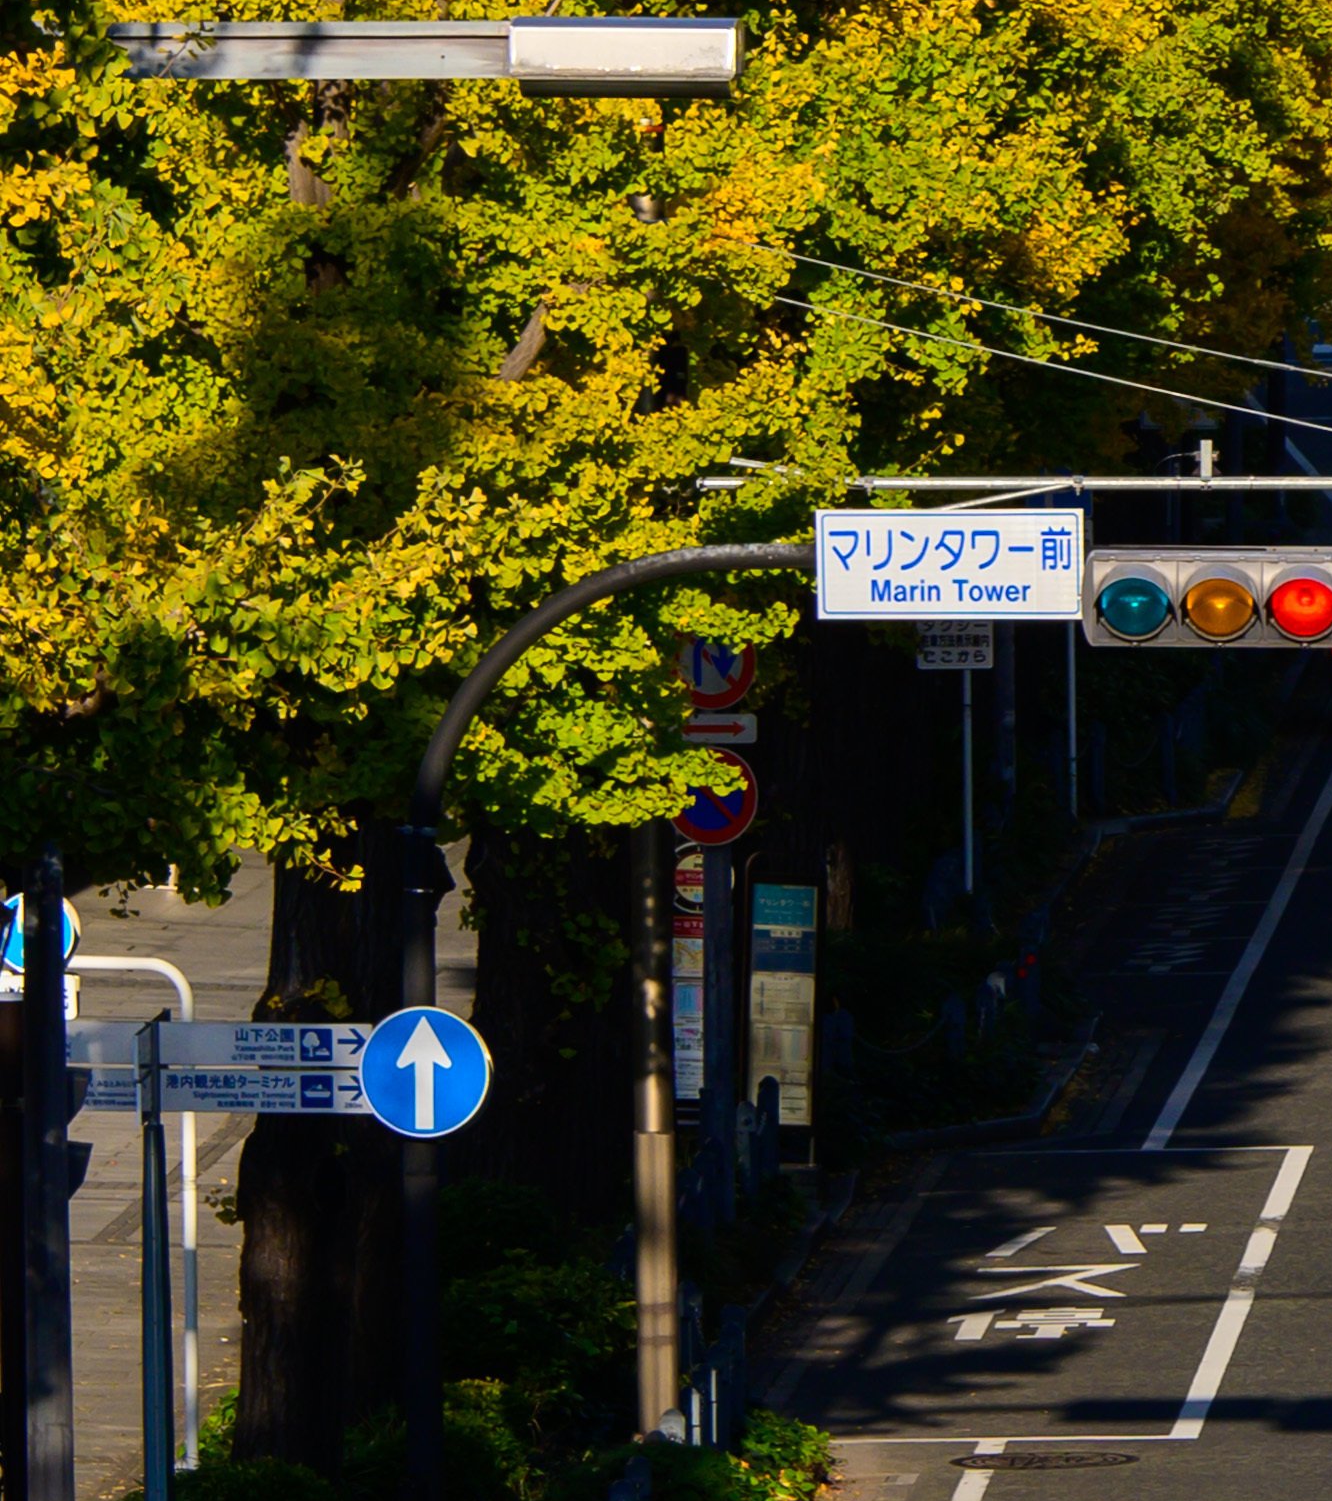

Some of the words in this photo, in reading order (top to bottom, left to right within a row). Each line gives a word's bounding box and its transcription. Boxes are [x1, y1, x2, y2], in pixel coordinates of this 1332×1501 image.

[828, 525, 1074, 572] マリンタワー前
[870, 579, 942, 603] Marin
[952, 579, 1031, 603] Tower
[235, 1028, 295, 1043] 山下公園
[165, 1074, 295, 1089] 港内観光船ターミナル
[947, 1222, 1209, 1341] バス停
